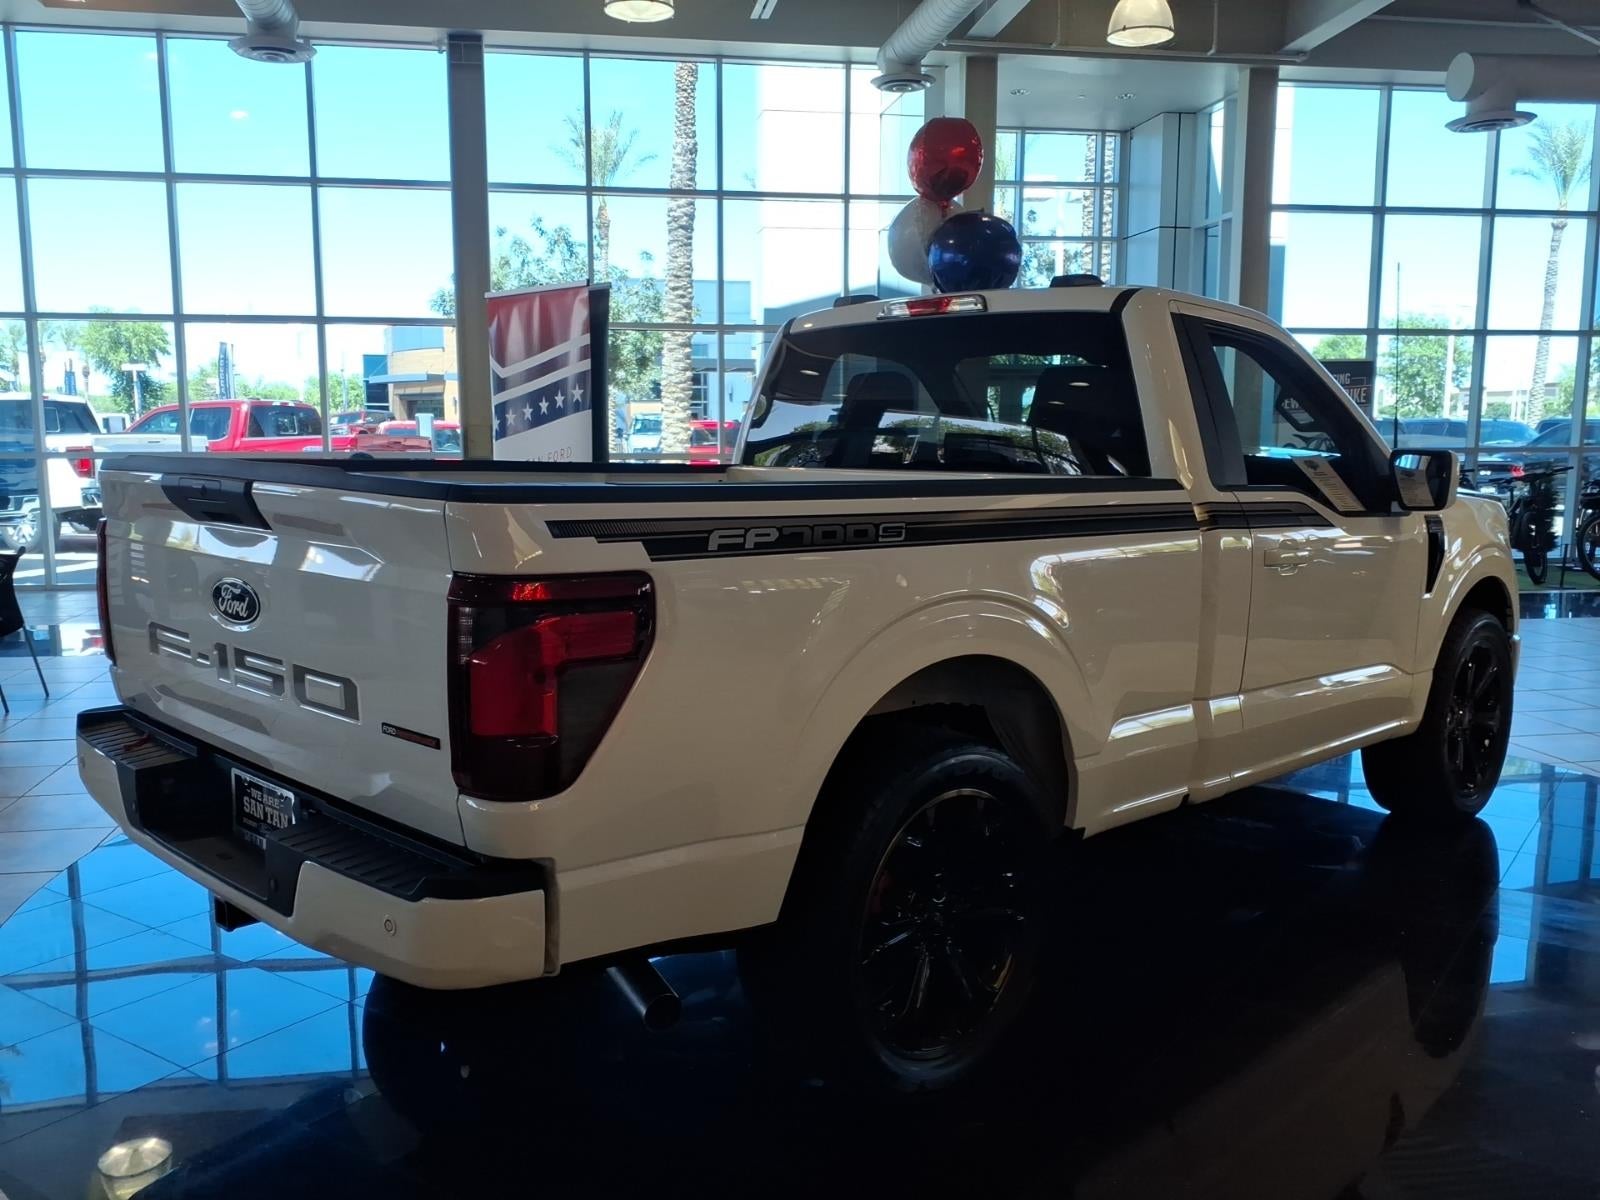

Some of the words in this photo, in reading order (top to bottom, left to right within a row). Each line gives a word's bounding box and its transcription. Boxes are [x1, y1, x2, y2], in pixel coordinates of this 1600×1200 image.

[707, 523, 906, 551] FP700S
[218, 584, 249, 618] Ford
[148, 621, 361, 725] F-150
[243, 796, 264, 820] SAN
[265, 806, 289, 829] TAN
[250, 787, 262, 801] WE
[262, 794, 280, 809] ARE
